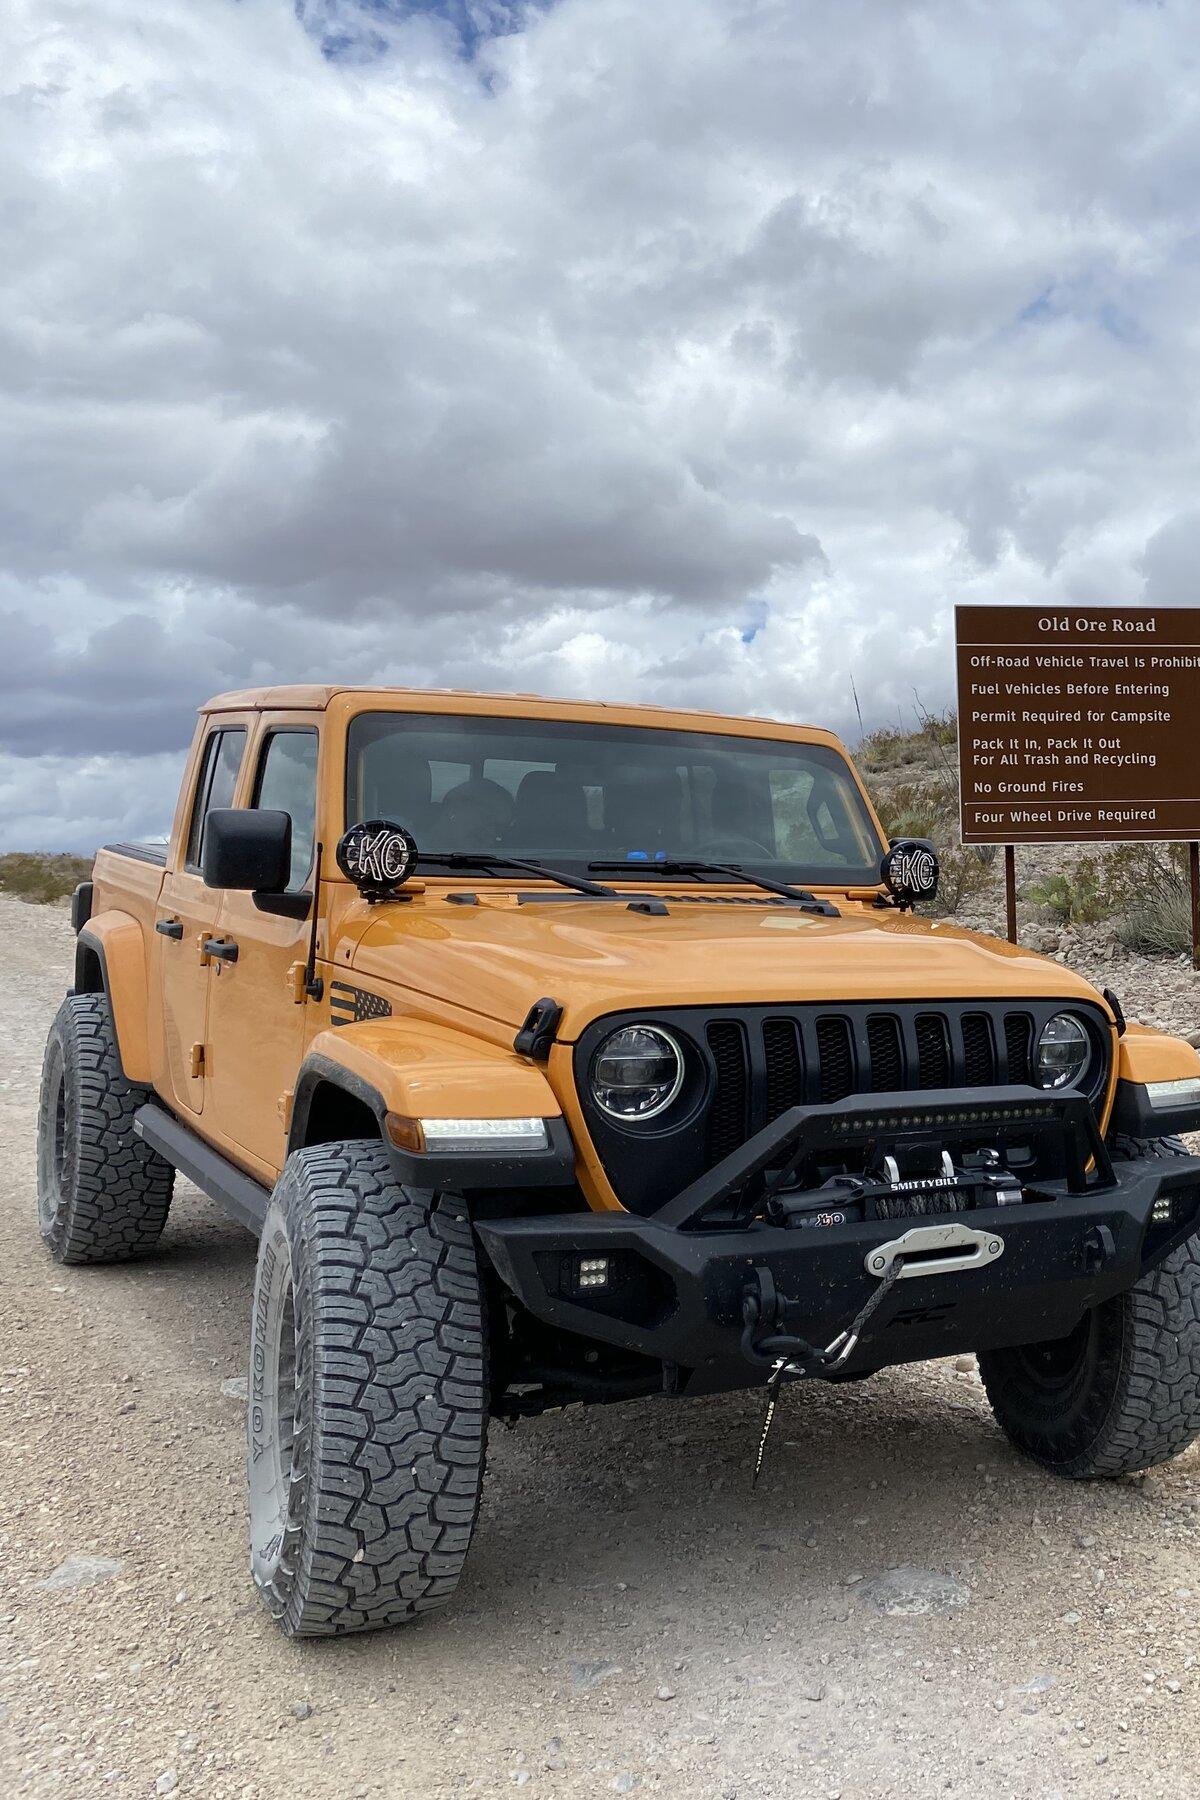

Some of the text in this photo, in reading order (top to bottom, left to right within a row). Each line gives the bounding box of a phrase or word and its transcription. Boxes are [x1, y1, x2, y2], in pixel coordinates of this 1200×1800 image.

[1038, 616, 1156, 632] Old Ore Road
[970, 655, 1030, 667] Off-Road
[1035, 655, 1084, 668] Vehicle
[1089, 656, 1129, 668] Travel
[1134, 657, 1146, 668] Is
[971, 682, 1170, 697] Fuel Vehicles Before Entering
[972, 709, 1171, 725] Permit Required for Campsite
[973, 737, 1121, 751] Pack It In, Pack It Out
[973, 752, 1156, 767] For All Trash and Recycling
[974, 780, 1084, 793] No Ground Fires
[974, 808, 1156, 824] Four Wheel Drive Required
[358, 830, 407, 882] KC
[902, 849, 935, 893] KC
[890, 1176, 960, 1192] SMITTYBILT
[252, 1242, 278, 1464] YOKOHAMA
